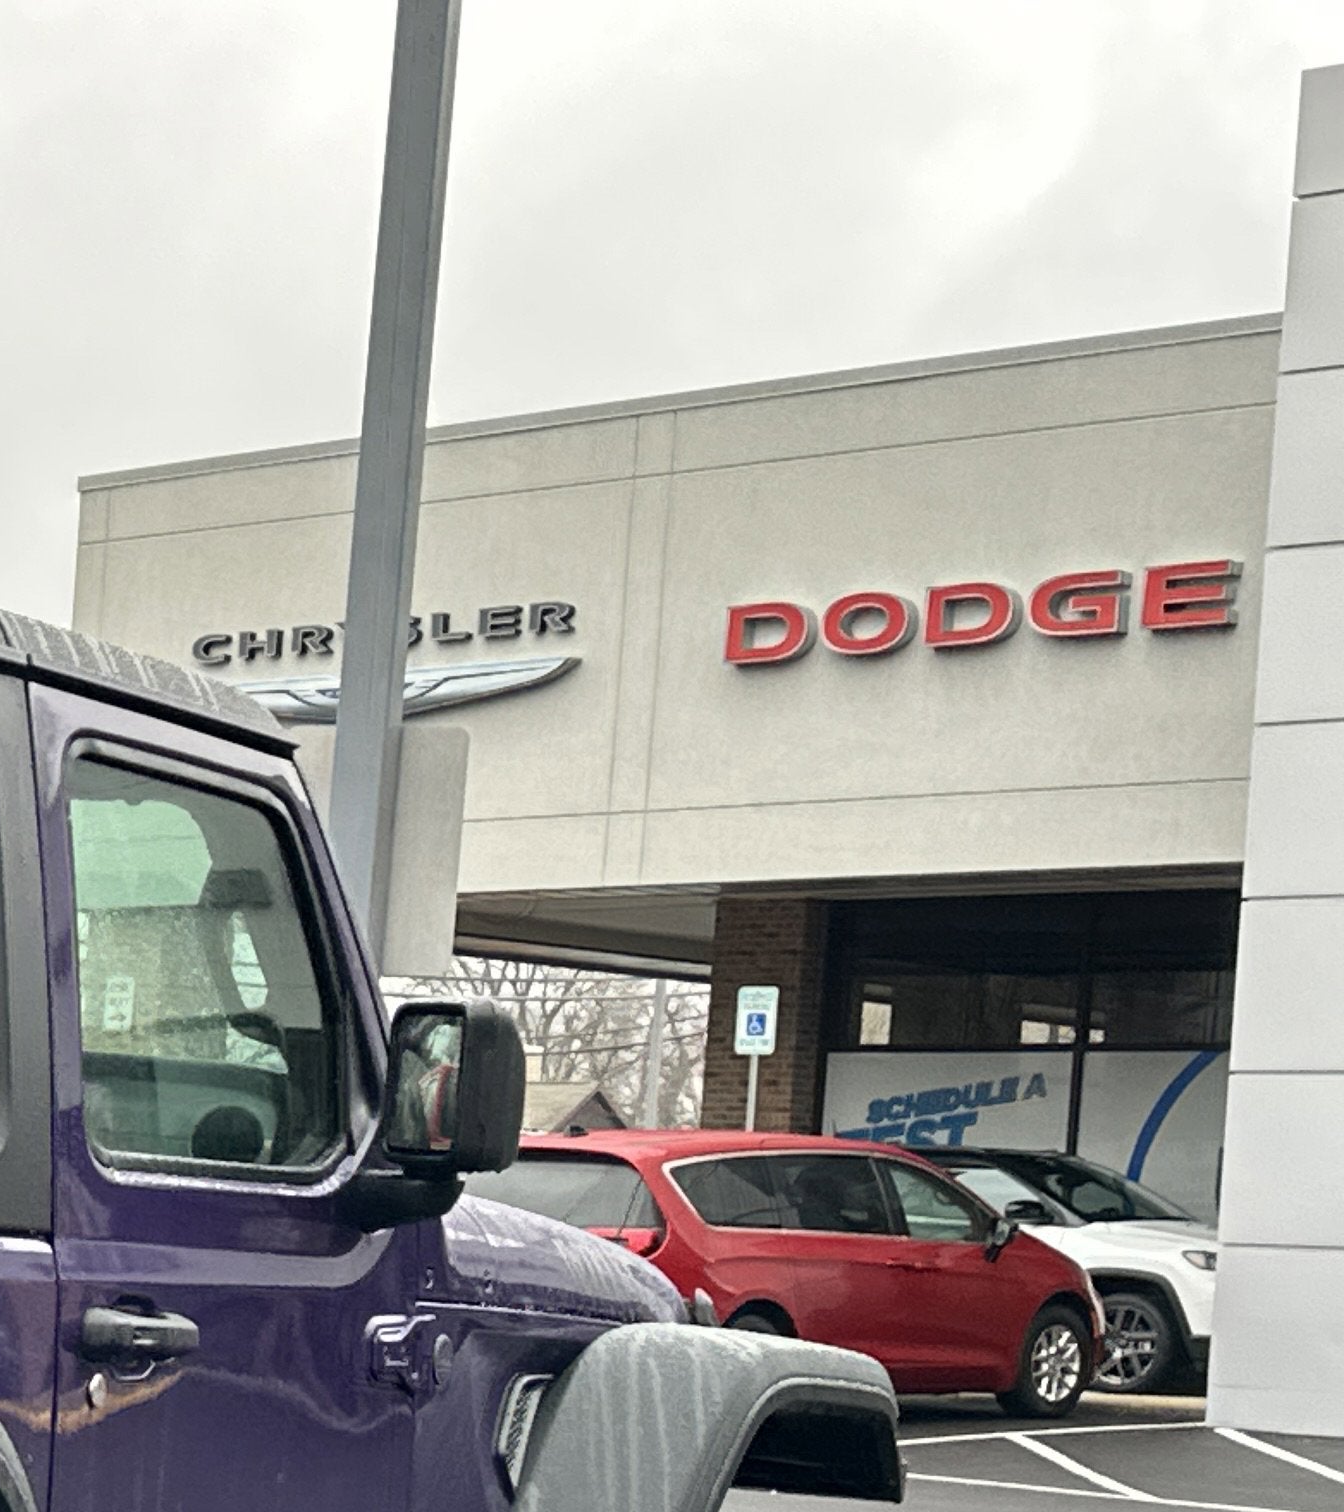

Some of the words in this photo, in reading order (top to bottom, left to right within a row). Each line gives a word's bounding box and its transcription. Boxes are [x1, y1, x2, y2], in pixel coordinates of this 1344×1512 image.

[192, 601, 576, 665] CHRLER
[723, 559, 1244, 669] DODGE
[865, 1076, 1020, 1123] SCHEDULE
[1021, 1072, 1048, 1101] A
